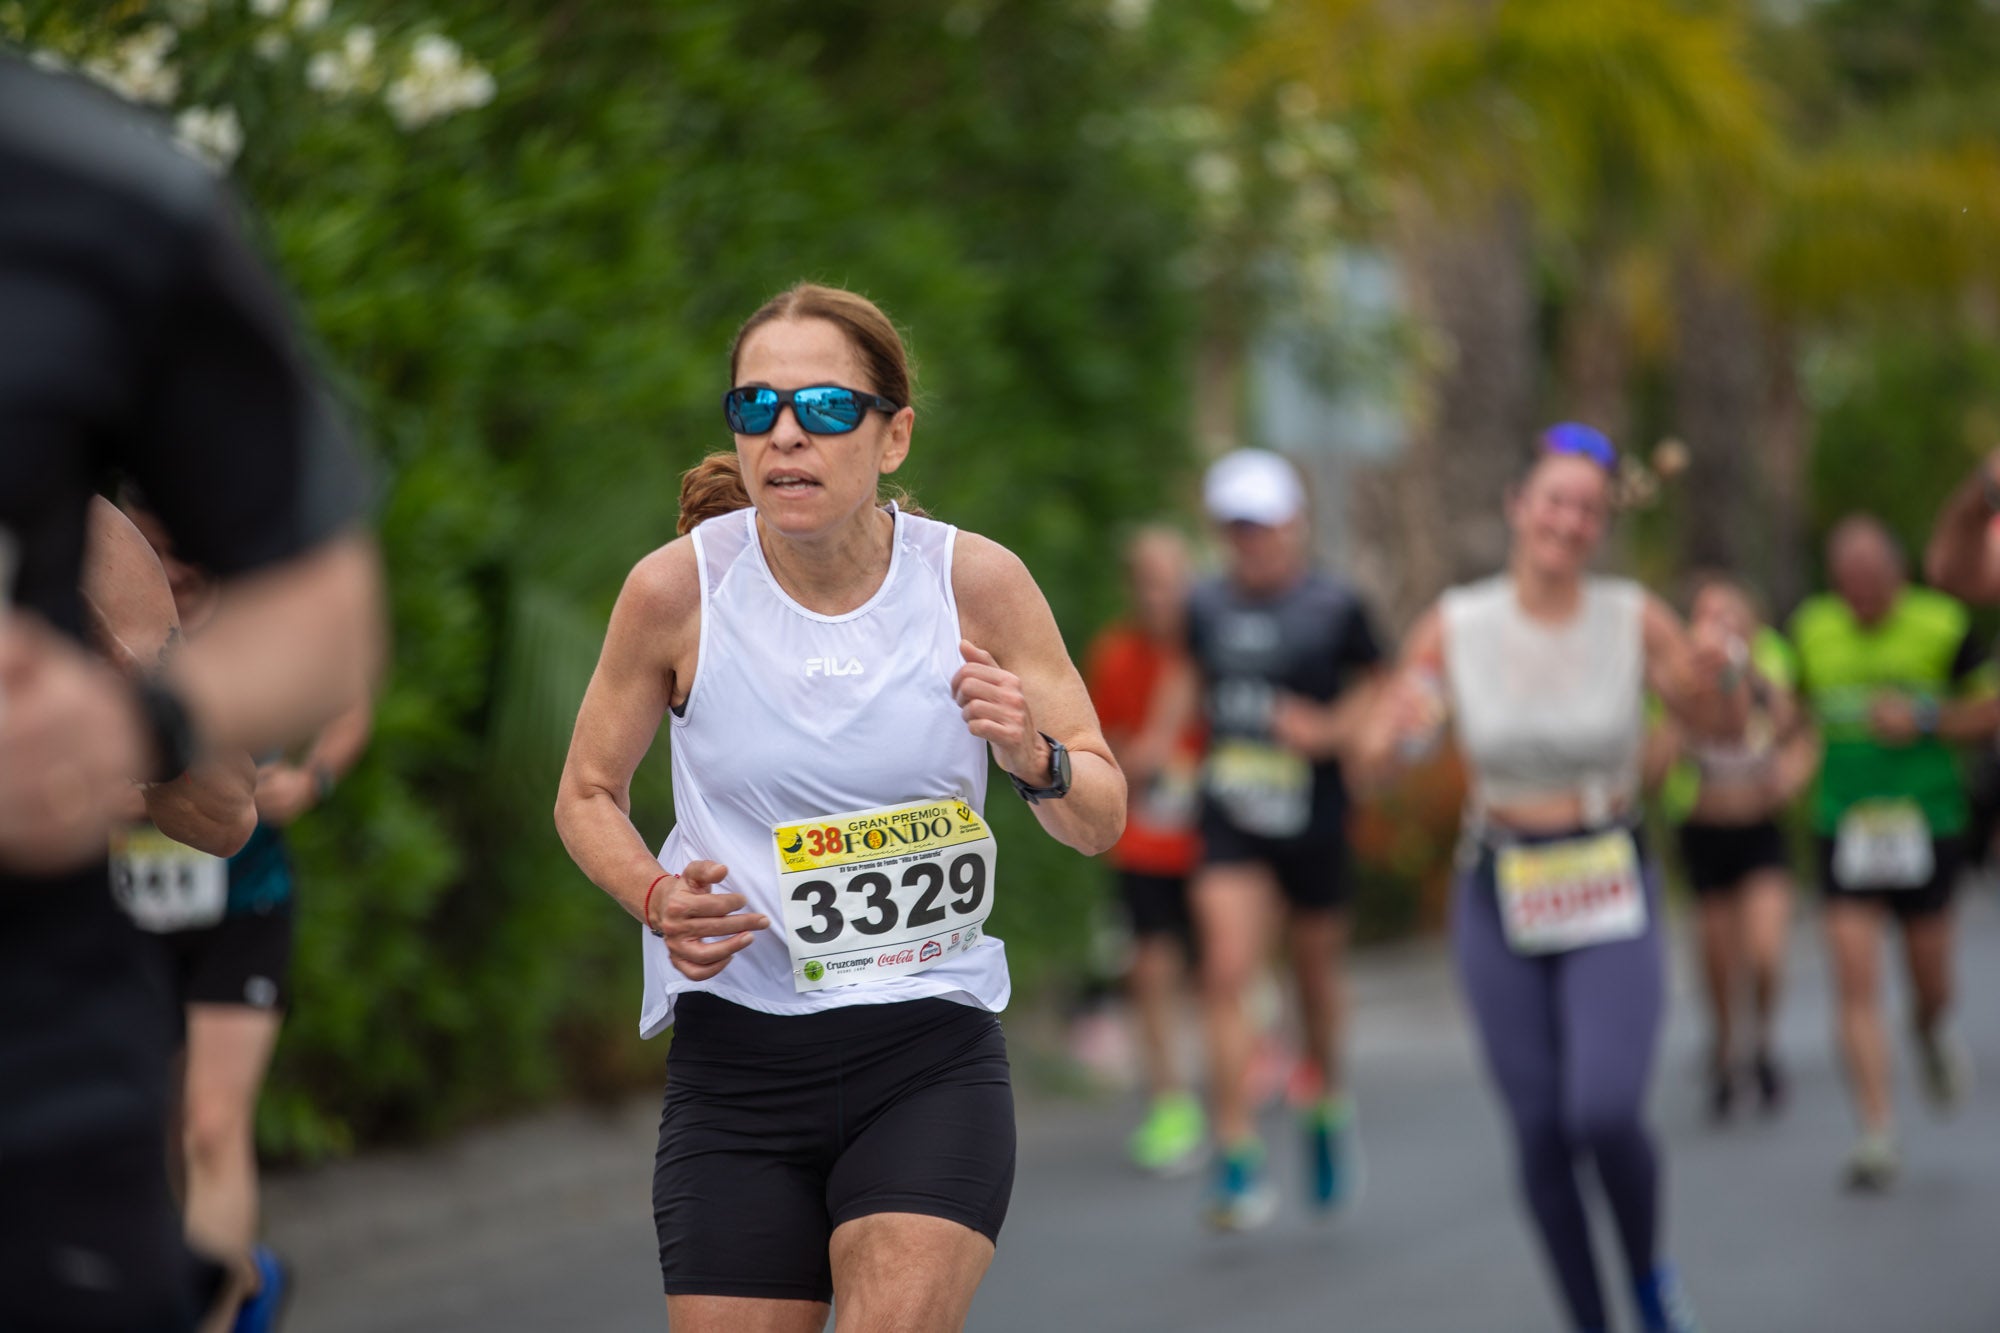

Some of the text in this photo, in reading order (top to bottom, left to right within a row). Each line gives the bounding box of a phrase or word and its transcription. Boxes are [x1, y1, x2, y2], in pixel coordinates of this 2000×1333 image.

[805, 656, 865, 677] FILA
[848, 816, 890, 832] GRAN
[892, 807, 941, 824] PREMIO
[806, 826, 844, 857] 38
[843, 816, 951, 854] FONDO
[871, 838, 881, 847] 25
[858, 863, 876, 871] Premio
[791, 852, 986, 944] 3329
[826, 956, 874, 971] Cruzcampo
